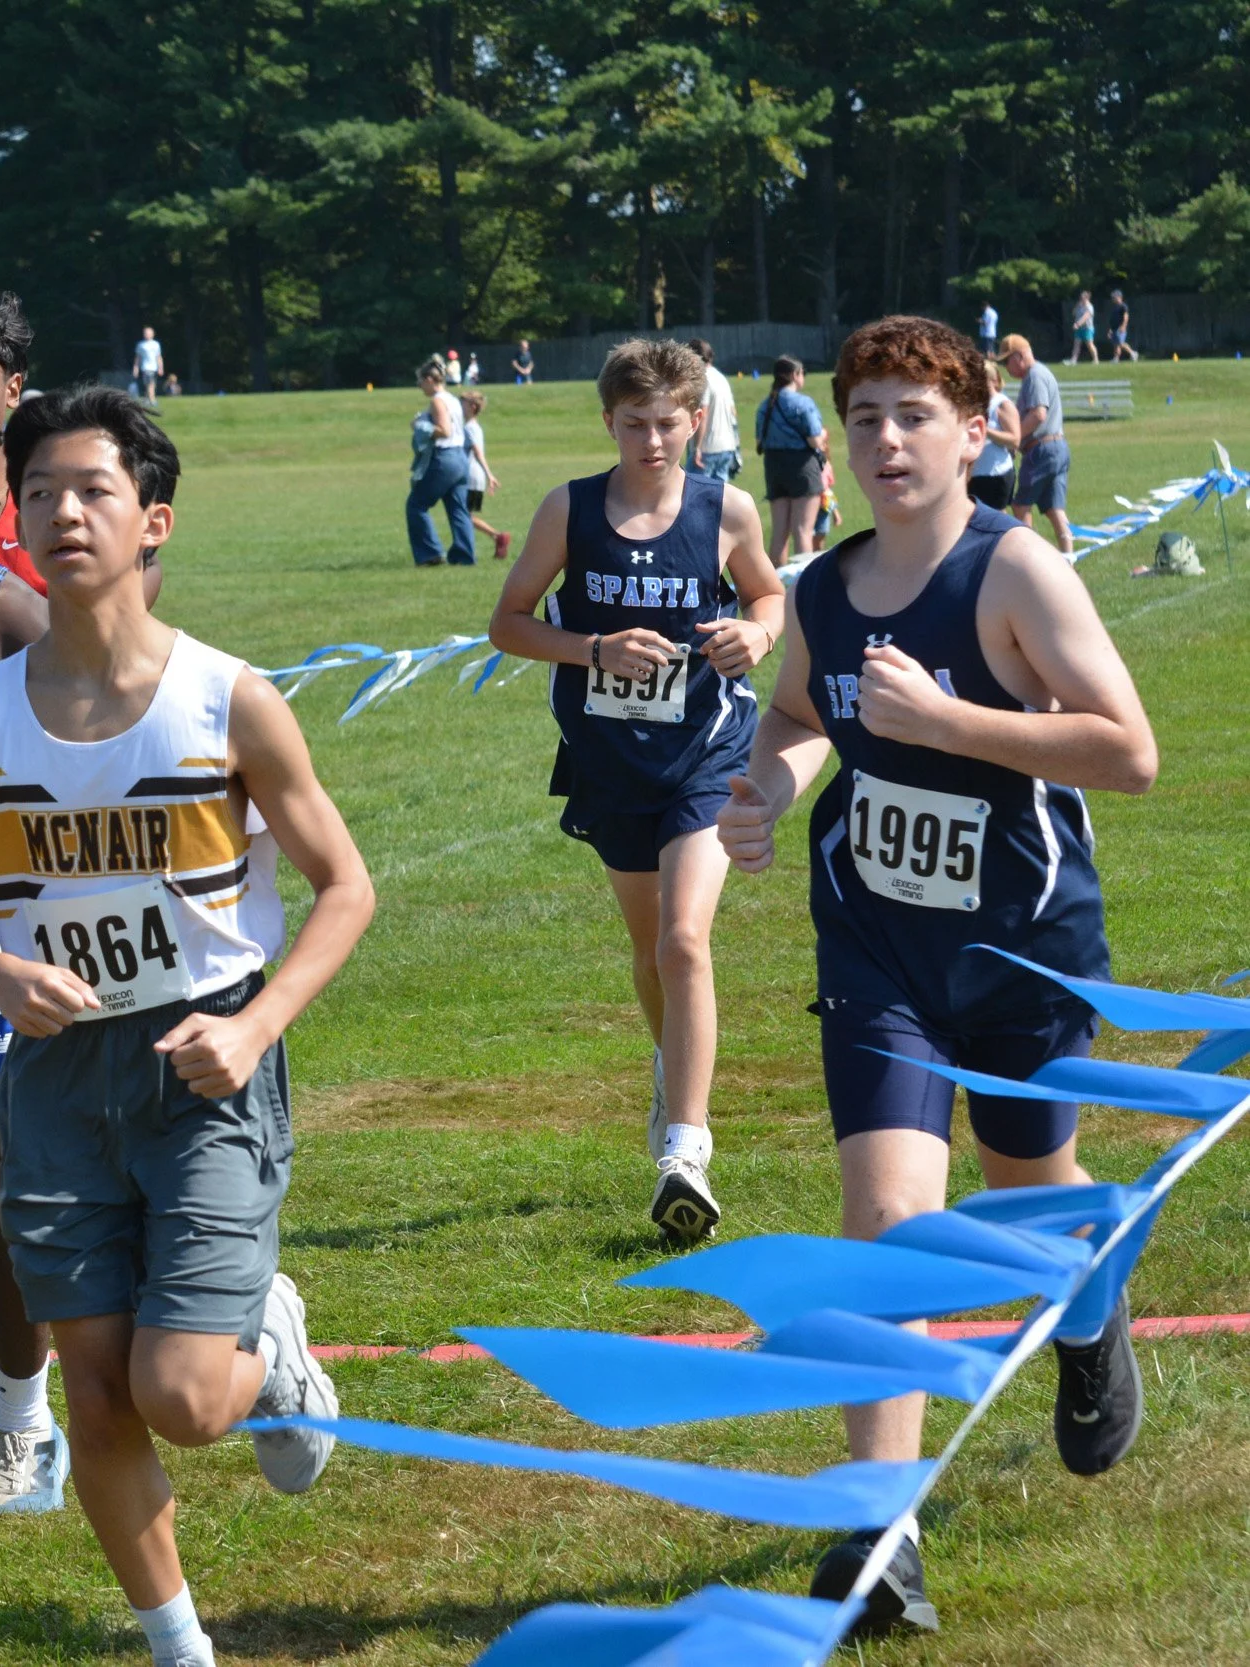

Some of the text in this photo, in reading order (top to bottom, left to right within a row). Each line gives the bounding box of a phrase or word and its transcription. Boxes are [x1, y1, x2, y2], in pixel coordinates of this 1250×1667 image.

[586, 571, 700, 608] SPARTA
[20, 806, 171, 877] MCNAIR
[854, 796, 979, 882] 1995
[891, 876, 924, 891] LEXICON
[34, 905, 178, 987] 1864
[105, 999, 136, 1011] TIMING
